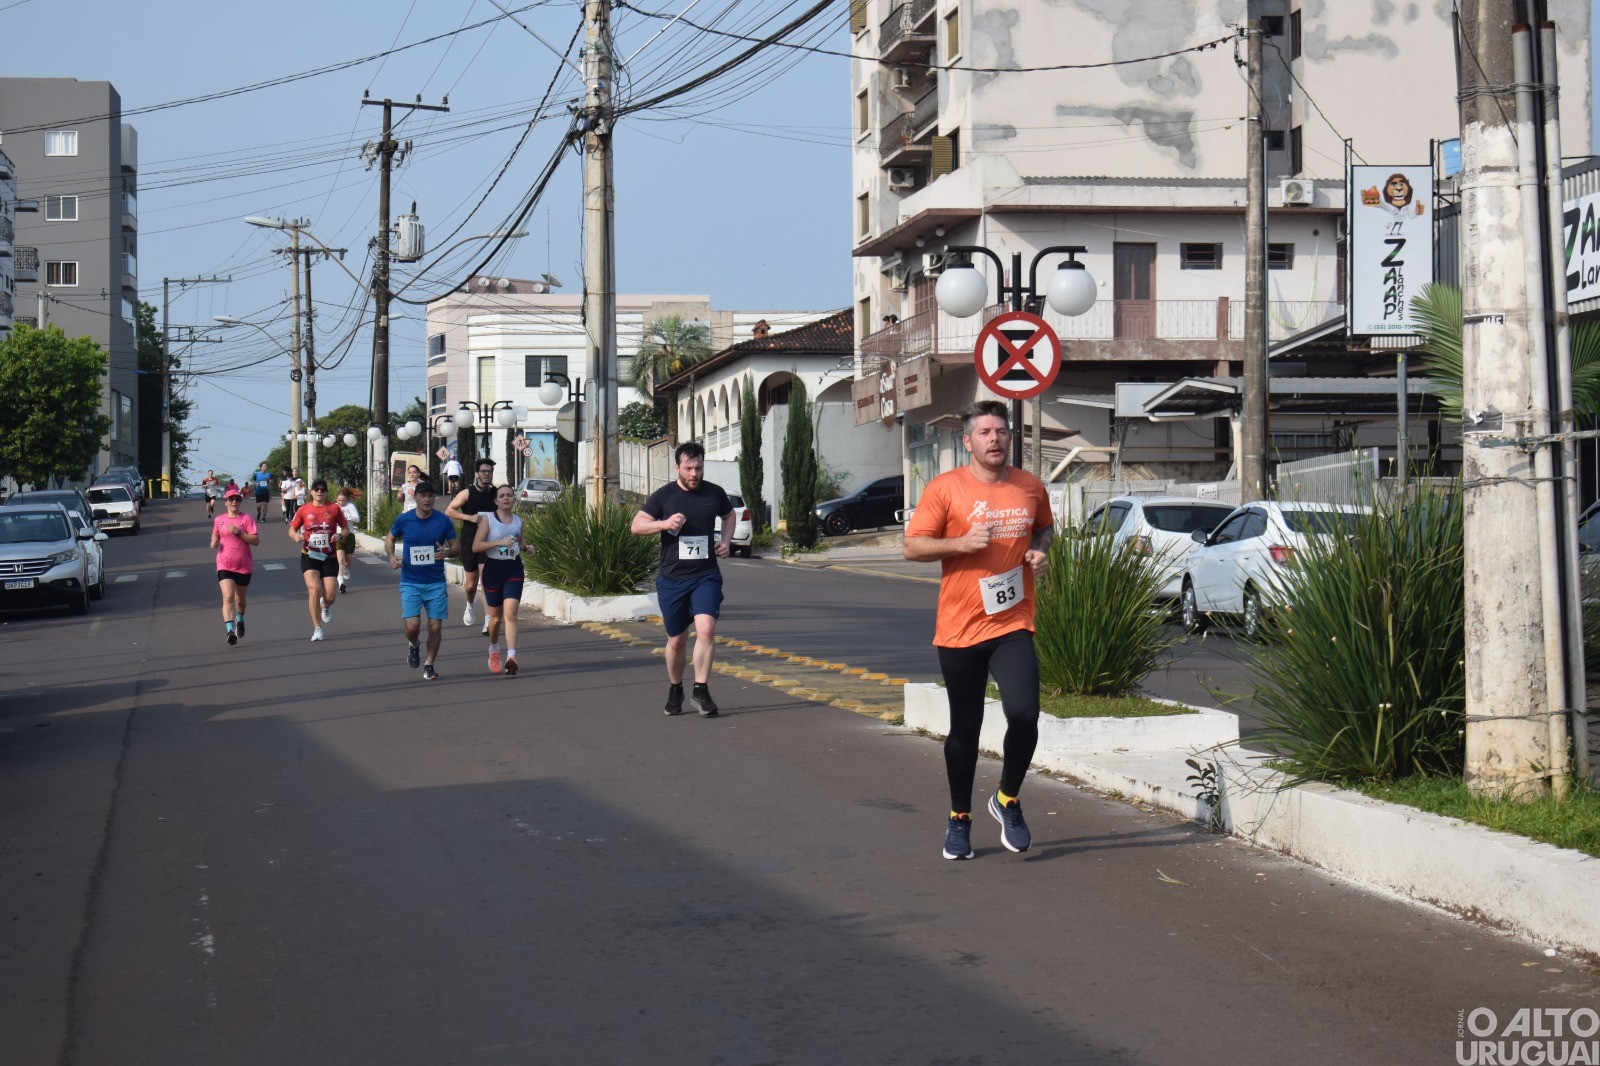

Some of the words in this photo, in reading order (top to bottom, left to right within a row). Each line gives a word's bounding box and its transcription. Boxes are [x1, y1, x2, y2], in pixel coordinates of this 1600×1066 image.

[1381, 238, 1407, 320] ZAAP
[986, 507, 1028, 519] RÚSTICA
[984, 519, 1003, 527] ANOS
[991, 525, 1026, 533] EDERICO
[686, 546, 700, 555] 71
[413, 554, 430, 562] 101
[996, 586, 1016, 605] 83
